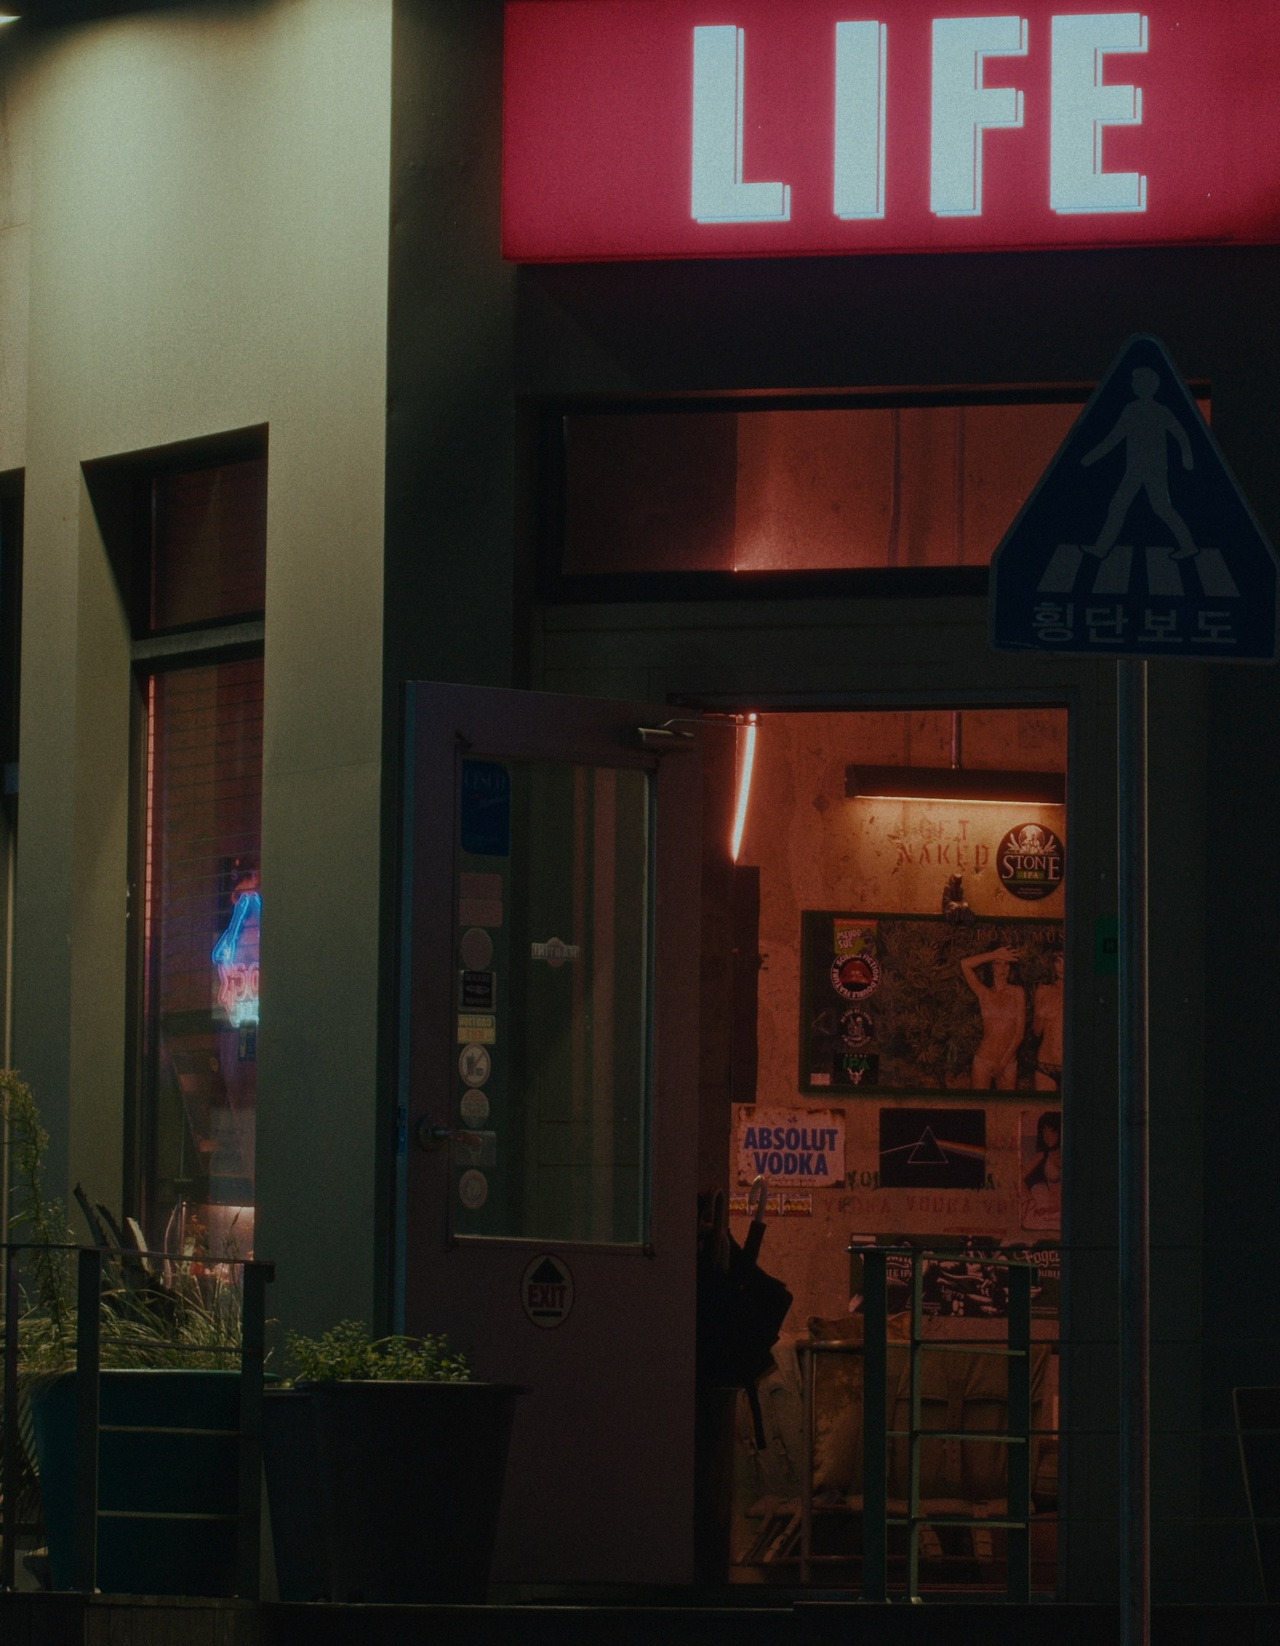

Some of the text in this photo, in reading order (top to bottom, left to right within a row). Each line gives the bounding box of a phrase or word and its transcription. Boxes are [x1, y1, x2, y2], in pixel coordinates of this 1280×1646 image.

[690, 11, 1153, 224] LIFE
[1032, 601, 1238, 644] 횡단보도
[900, 844, 990, 866] NAKED
[1002, 856, 1061, 881] STONE
[838, 937, 853, 949] SUE
[743, 1126, 839, 1152] ABSOLUT
[752, 1152, 830, 1176] VODKA
[527, 1283, 567, 1309] EXIT
